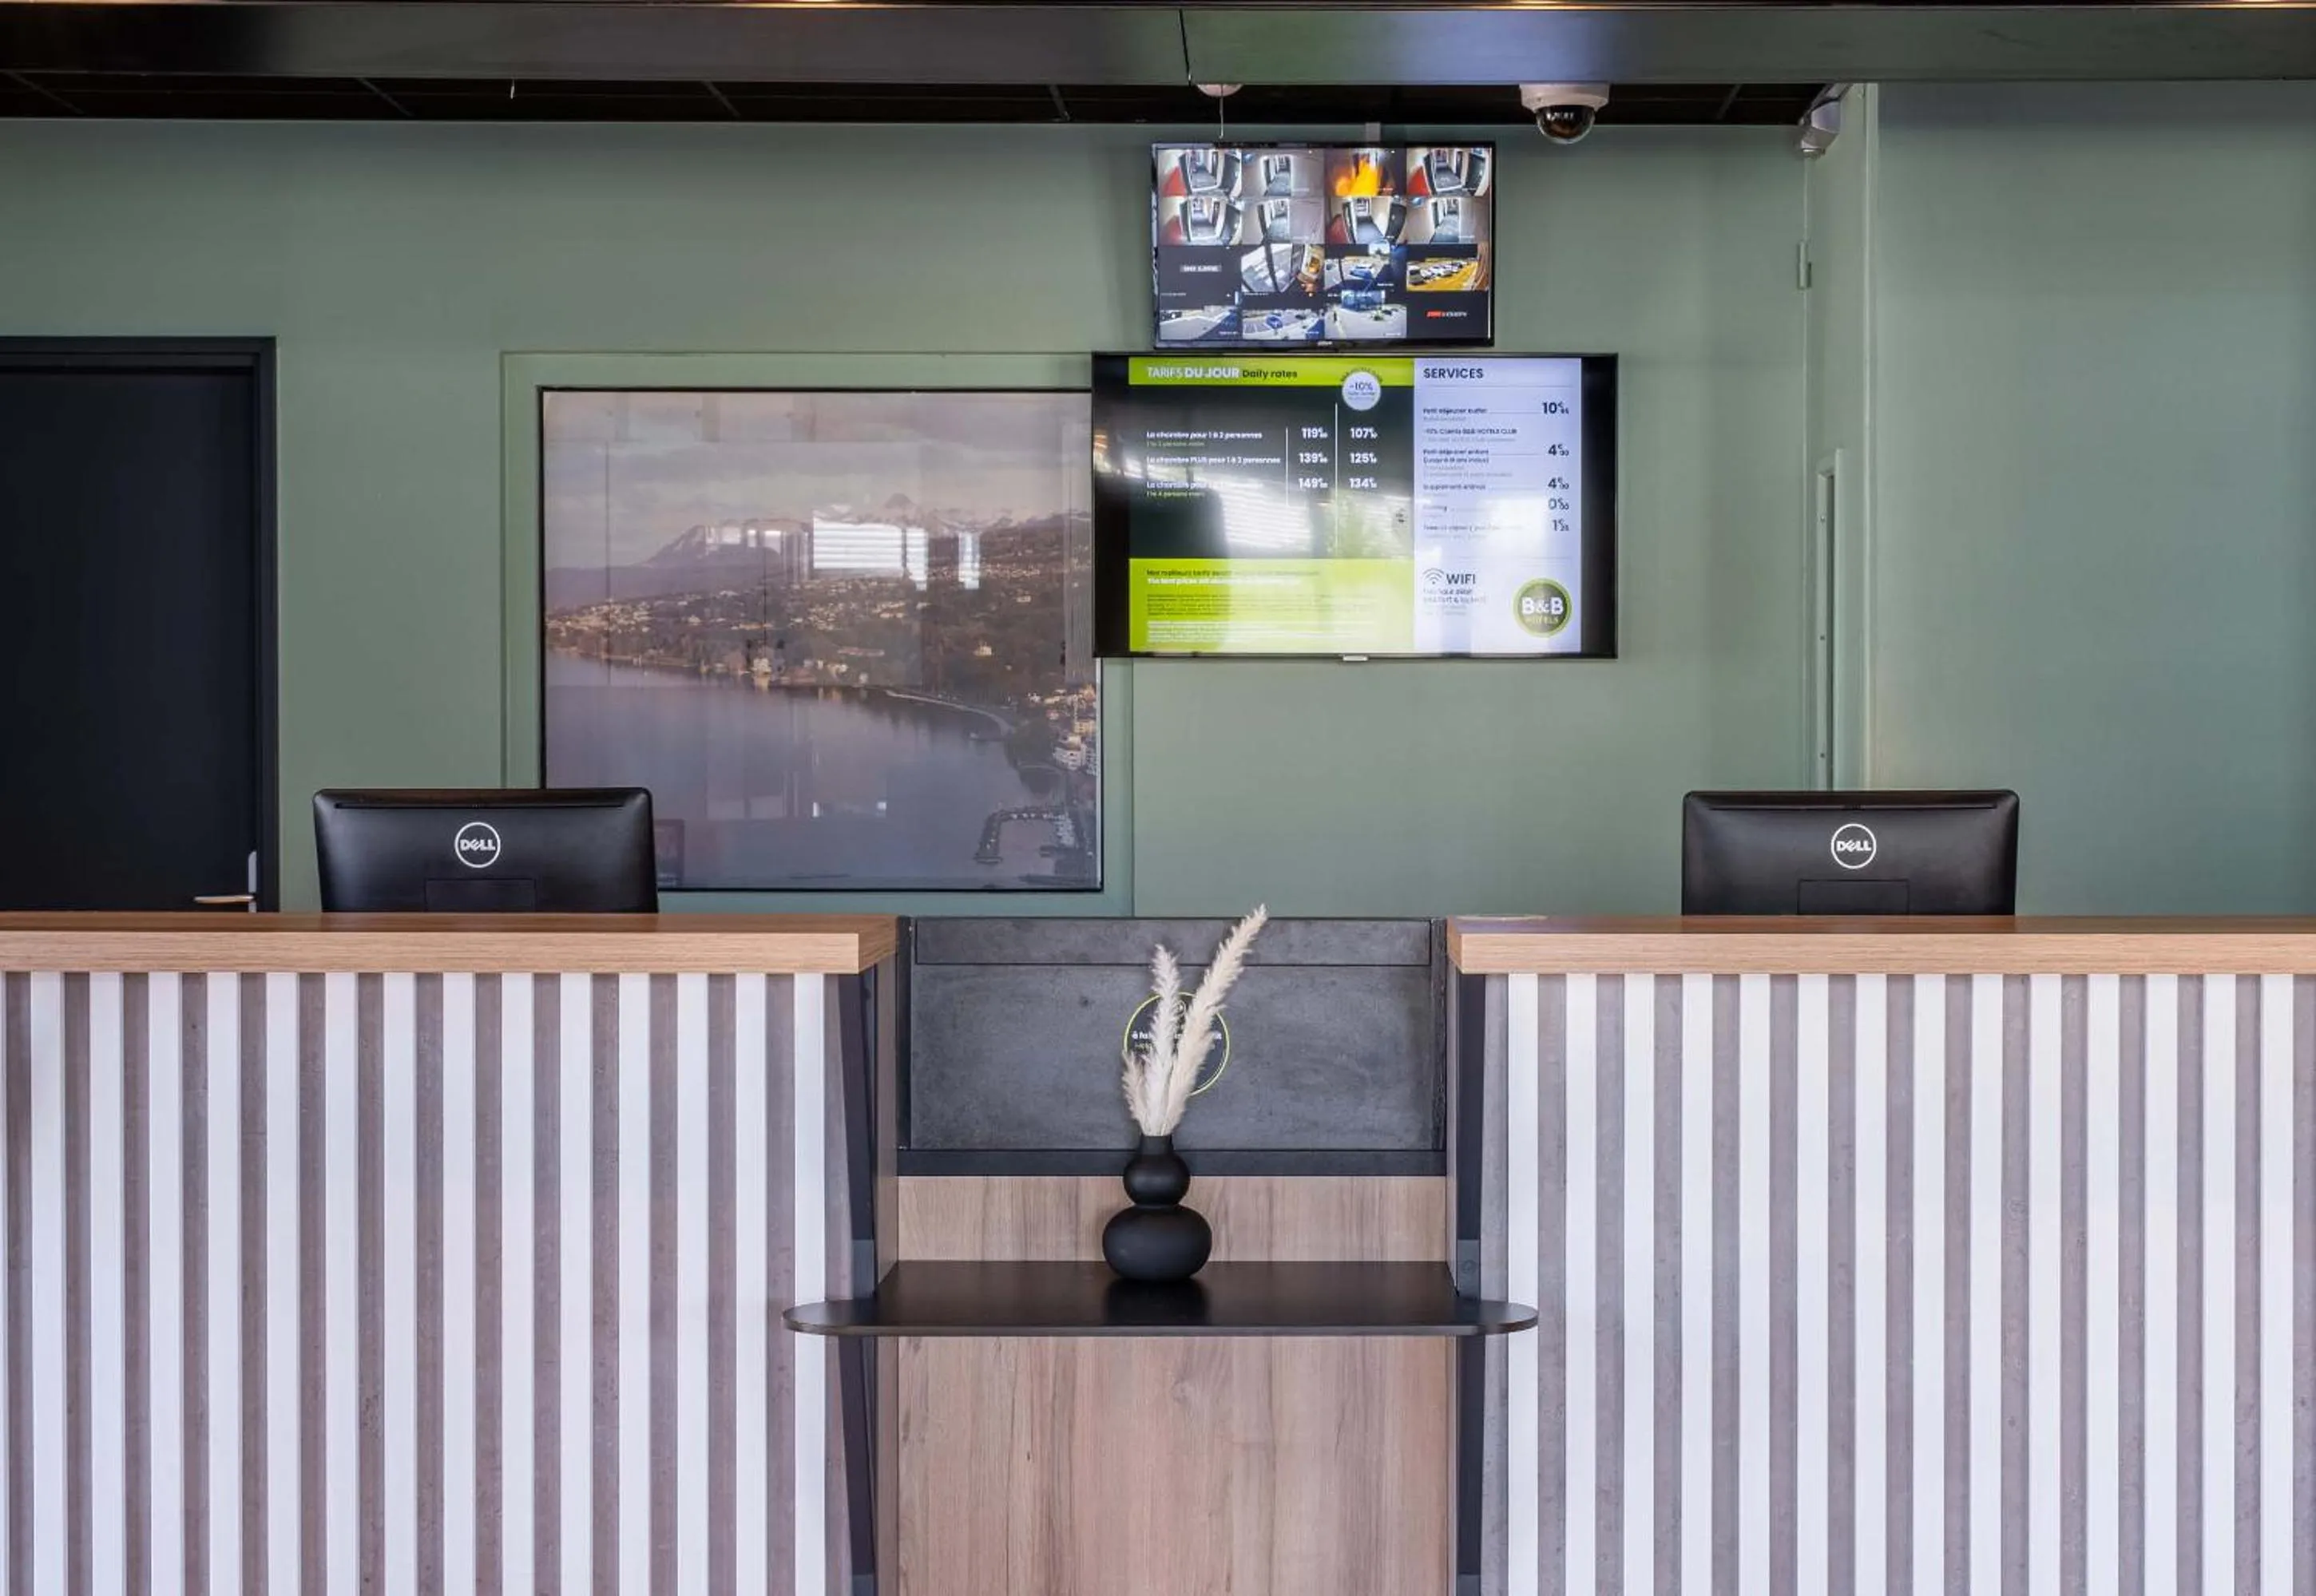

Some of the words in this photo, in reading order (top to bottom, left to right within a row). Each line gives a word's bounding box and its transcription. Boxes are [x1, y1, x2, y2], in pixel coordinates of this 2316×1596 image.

[1147, 366, 1183, 378] TARIFS
[1184, 366, 1203, 378] DU
[1204, 366, 1240, 378] JOUR
[1242, 369, 1268, 379] Daily
[1423, 368, 1484, 379] SERVICES
[1446, 573, 1476, 584] WIFI
[1521, 596, 1564, 615] B&B
[460, 839, 496, 851] DELL
[1837, 839, 1872, 852] DELL
